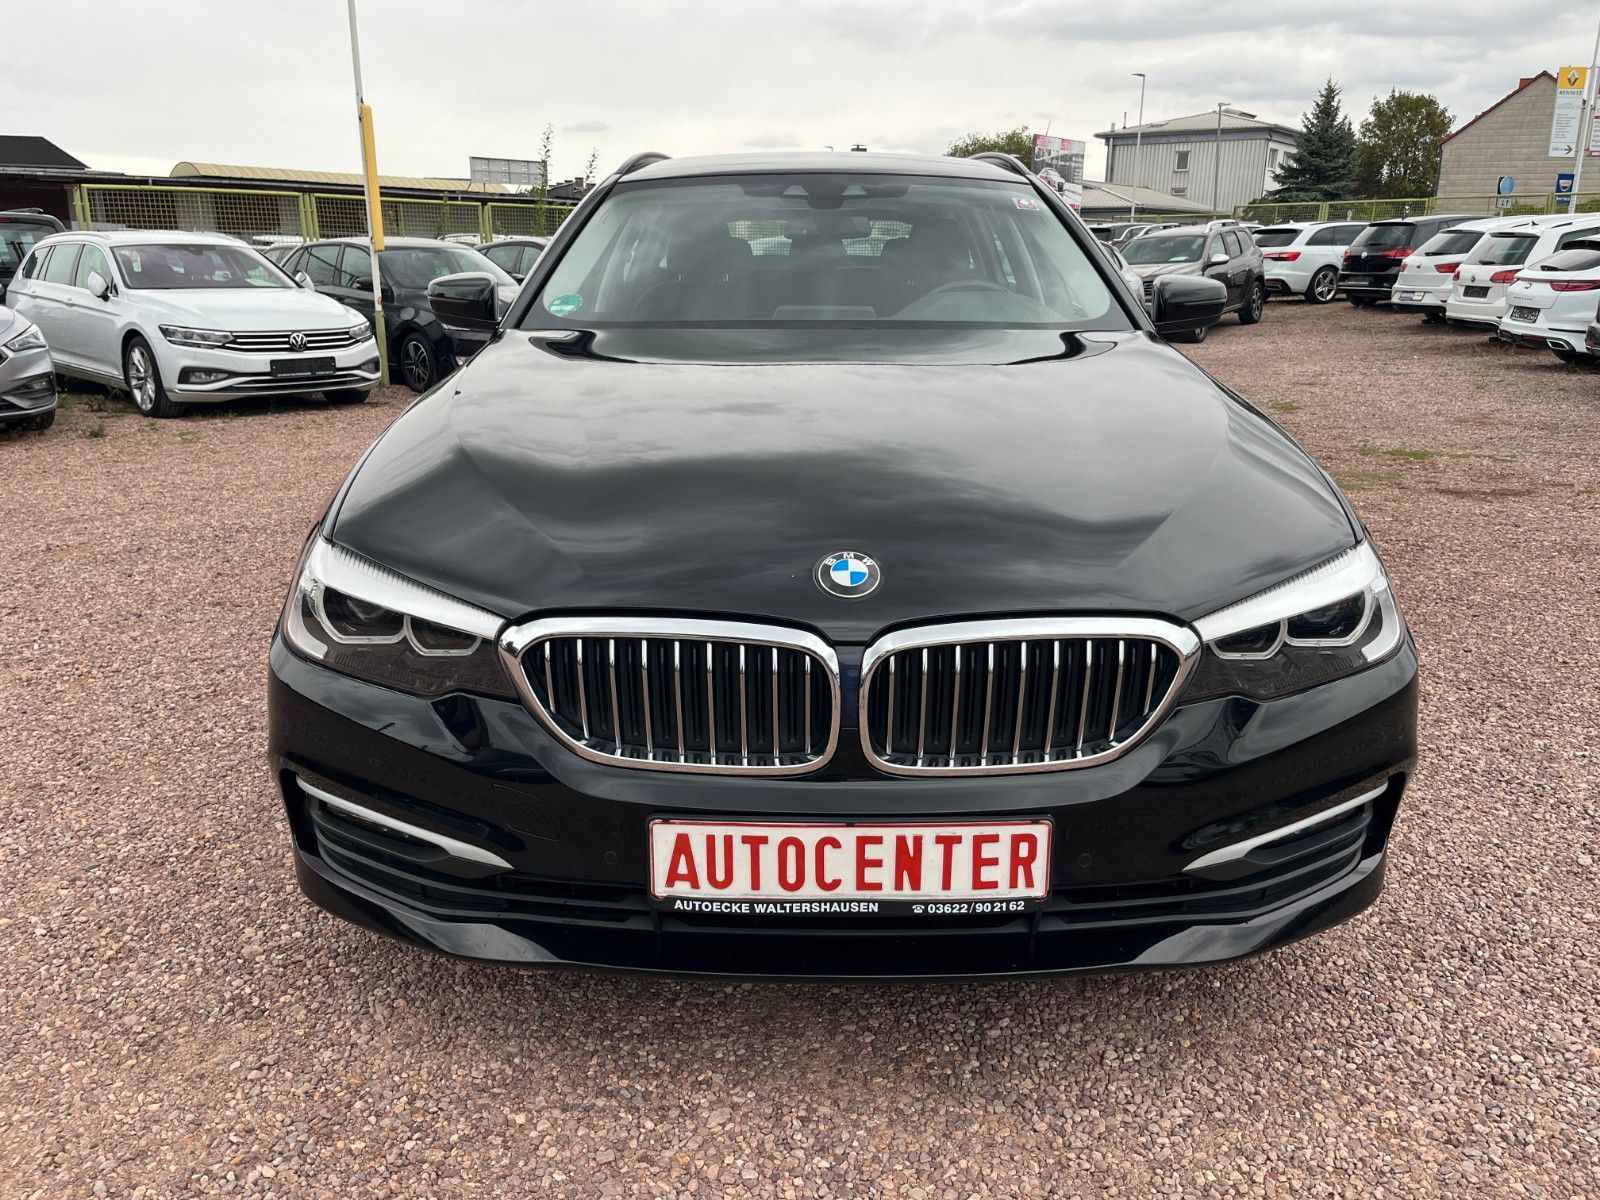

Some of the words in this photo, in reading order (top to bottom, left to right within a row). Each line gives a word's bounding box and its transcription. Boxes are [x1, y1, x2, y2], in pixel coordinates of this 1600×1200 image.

[824, 552, 875, 566] BMW
[665, 832, 1038, 892] AUTOCENTER
[674, 900, 750, 913] AUTOECKE
[754, 902, 879, 914] WALTERSHAUSEN
